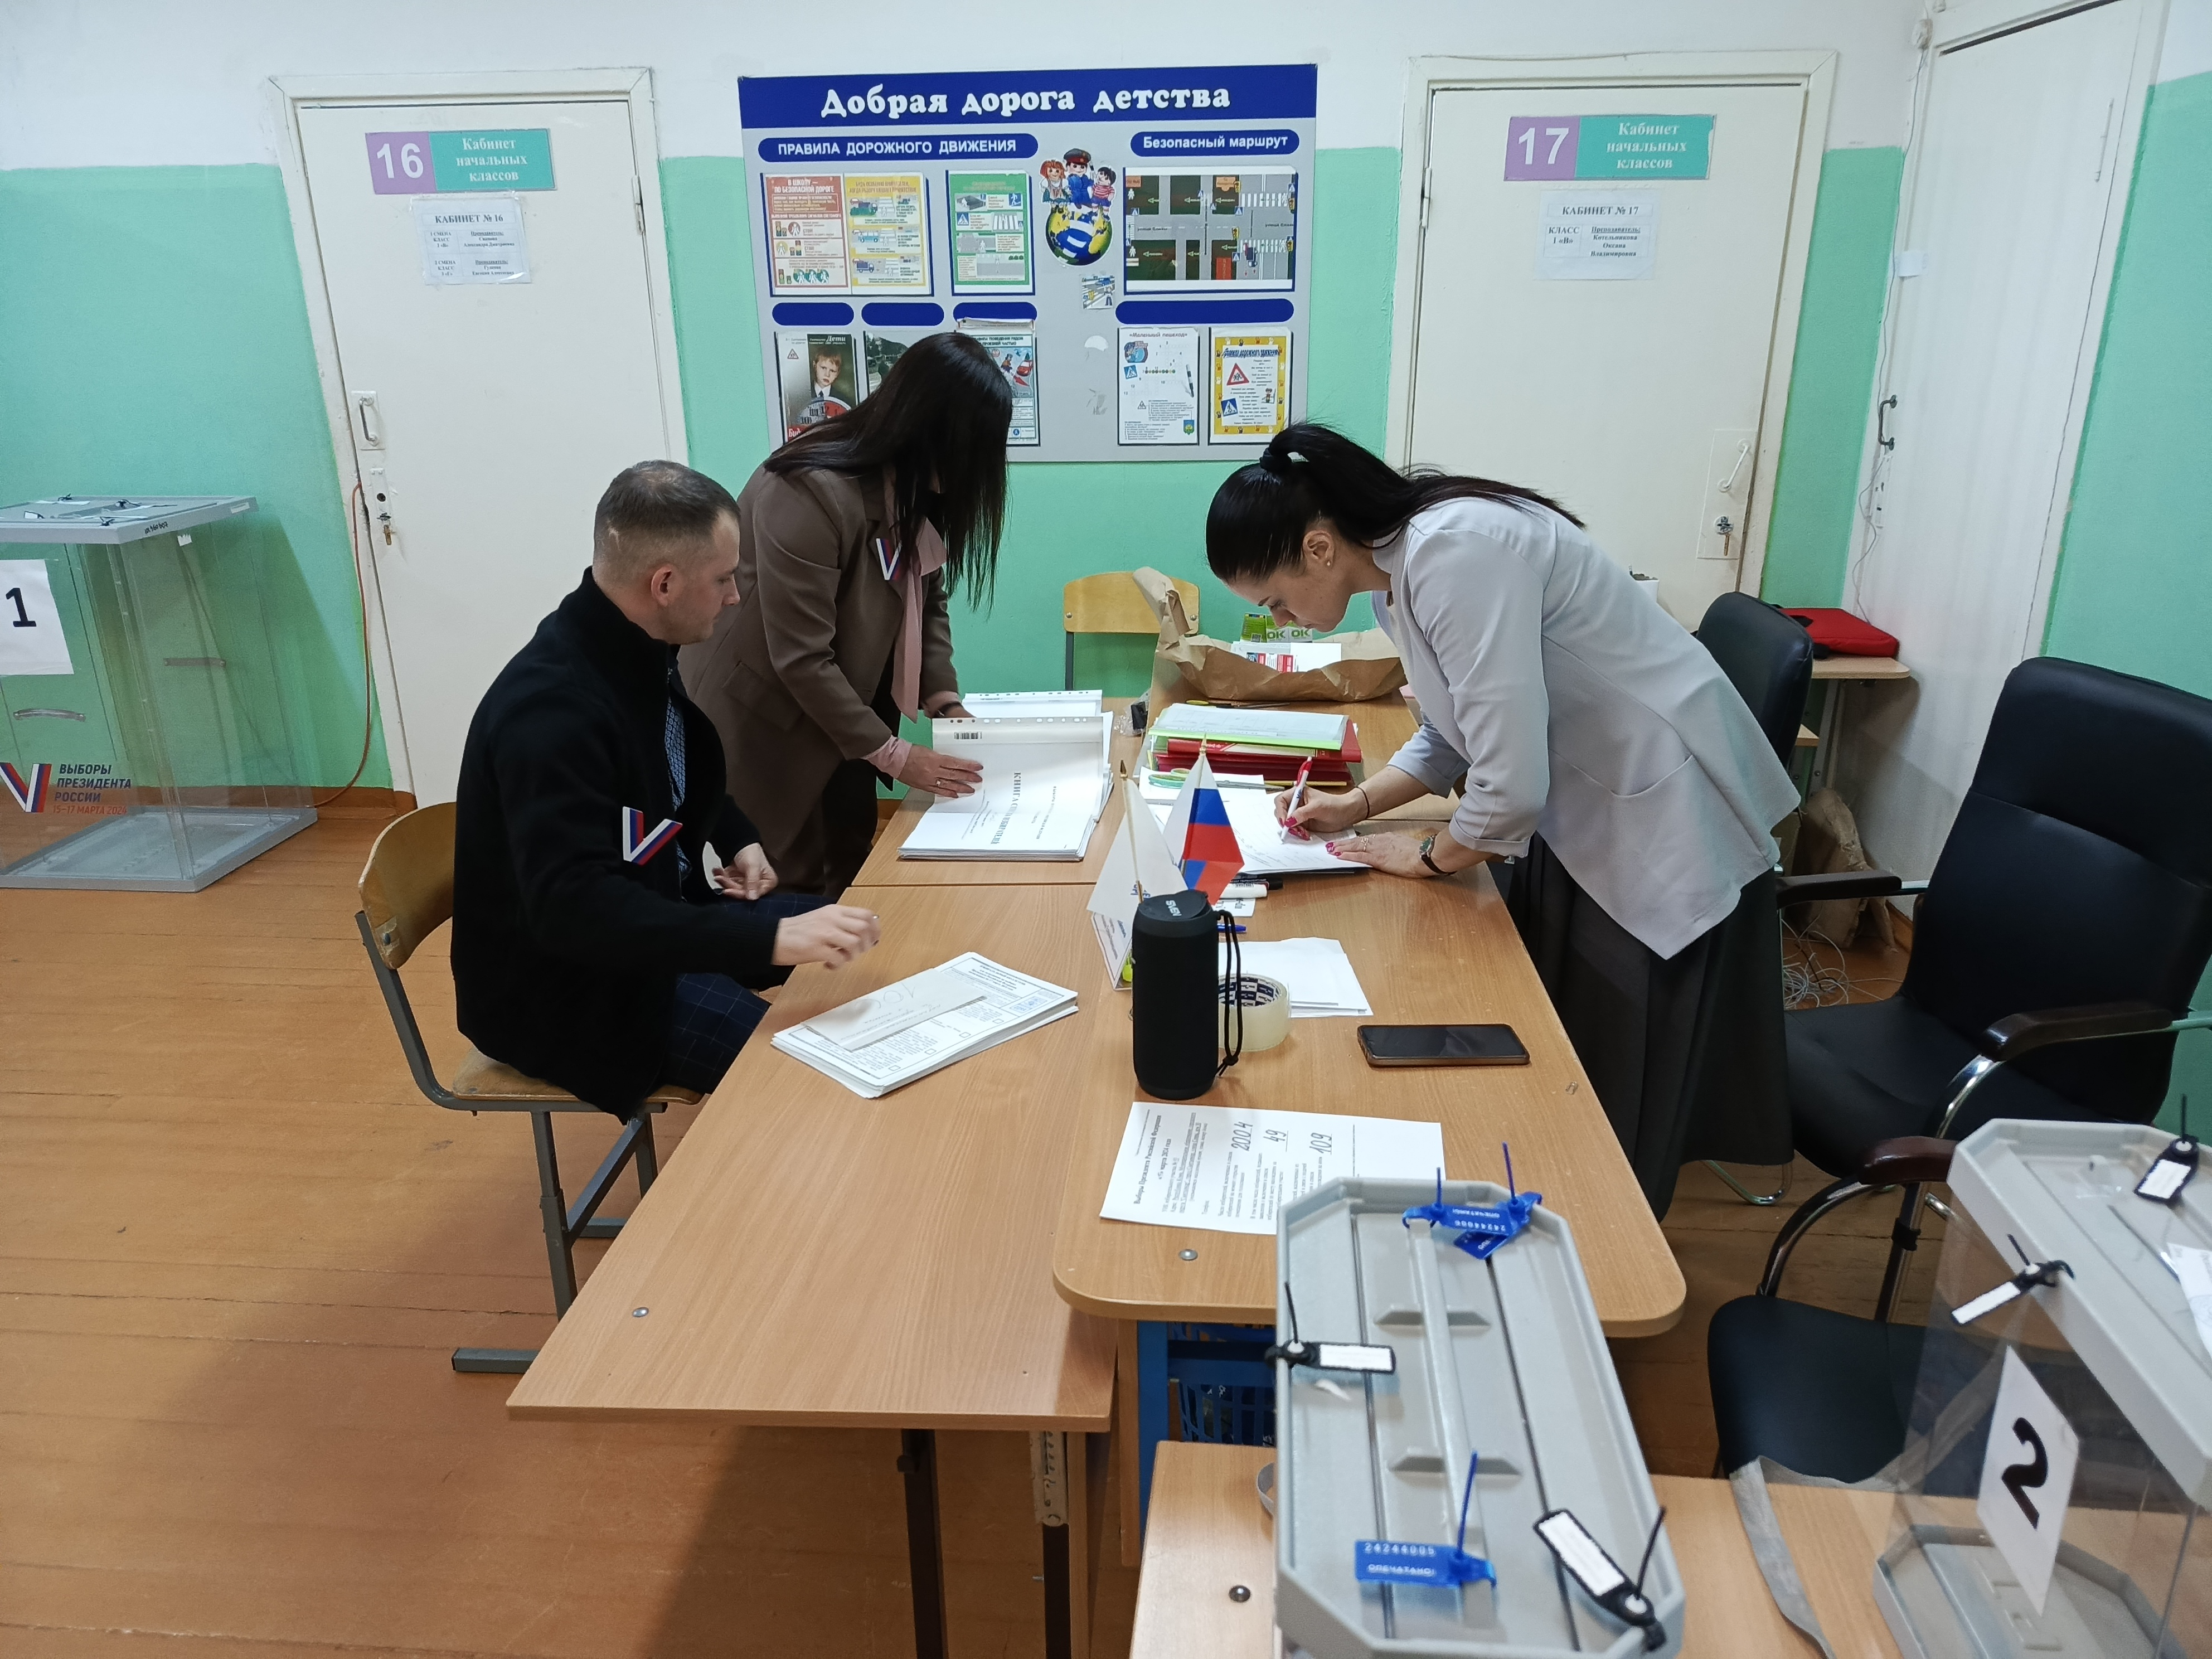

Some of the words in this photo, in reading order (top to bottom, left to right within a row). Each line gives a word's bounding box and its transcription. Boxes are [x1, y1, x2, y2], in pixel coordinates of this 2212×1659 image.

[821, 84, 948, 119] Добрая
[961, 90, 1075, 117] дорога
[1093, 89, 1230, 113] детства
[1619, 123, 1680, 135] Кабинет
[462, 138, 516, 151] Кабинет
[778, 142, 841, 156] ПРАВИЛА
[846, 141, 932, 156] ДОРОЖНОГО
[939, 140, 1016, 155] ДВИЖЕНИЯ
[1143, 135, 1225, 148] Безопасный
[1229, 136, 1288, 149] маршрут
[1518, 127, 1569, 165] 17
[1606, 140, 1687, 153] начальных
[376, 143, 424, 179] 16
[456, 156, 528, 167] начальных
[1617, 158, 1673, 169] классов
[469, 172, 520, 182] классов
[782, 185, 814, 193] БЕЗОПАСНОЙ
[1562, 206, 1613, 215] КАБИНЕТ
[1615, 206, 1626, 215] №
[1629, 206, 1639, 215] 17
[435, 215, 481, 223] КАБИНЕТ
[6, 587, 37, 627] 1
[1267, 629, 1286, 639] OK
[1291, 629, 1310, 637] OK
[59, 764, 112, 775] ВЫБОРЫ
[56, 778, 132, 790] ПРЕЗИДЕНТА
[1012, 772, 1021, 802] КНИГА
[54, 792, 101, 803] РОССИИ
[77, 806, 105, 814] МАРТА
[106, 806, 128, 815] 2024
[991, 817, 1011, 845] ИЗБИРАТЕЛЕЙ
[1165, 900, 1182, 916] SVEN
[1231, 1122, 1253, 1152] 2004
[1263, 1129, 1287, 1142] 49
[1309, 1133, 1332, 1153] 109
[1133, 1186, 1144, 1204] Выборы
[2001, 1417, 2048, 1531] 2
